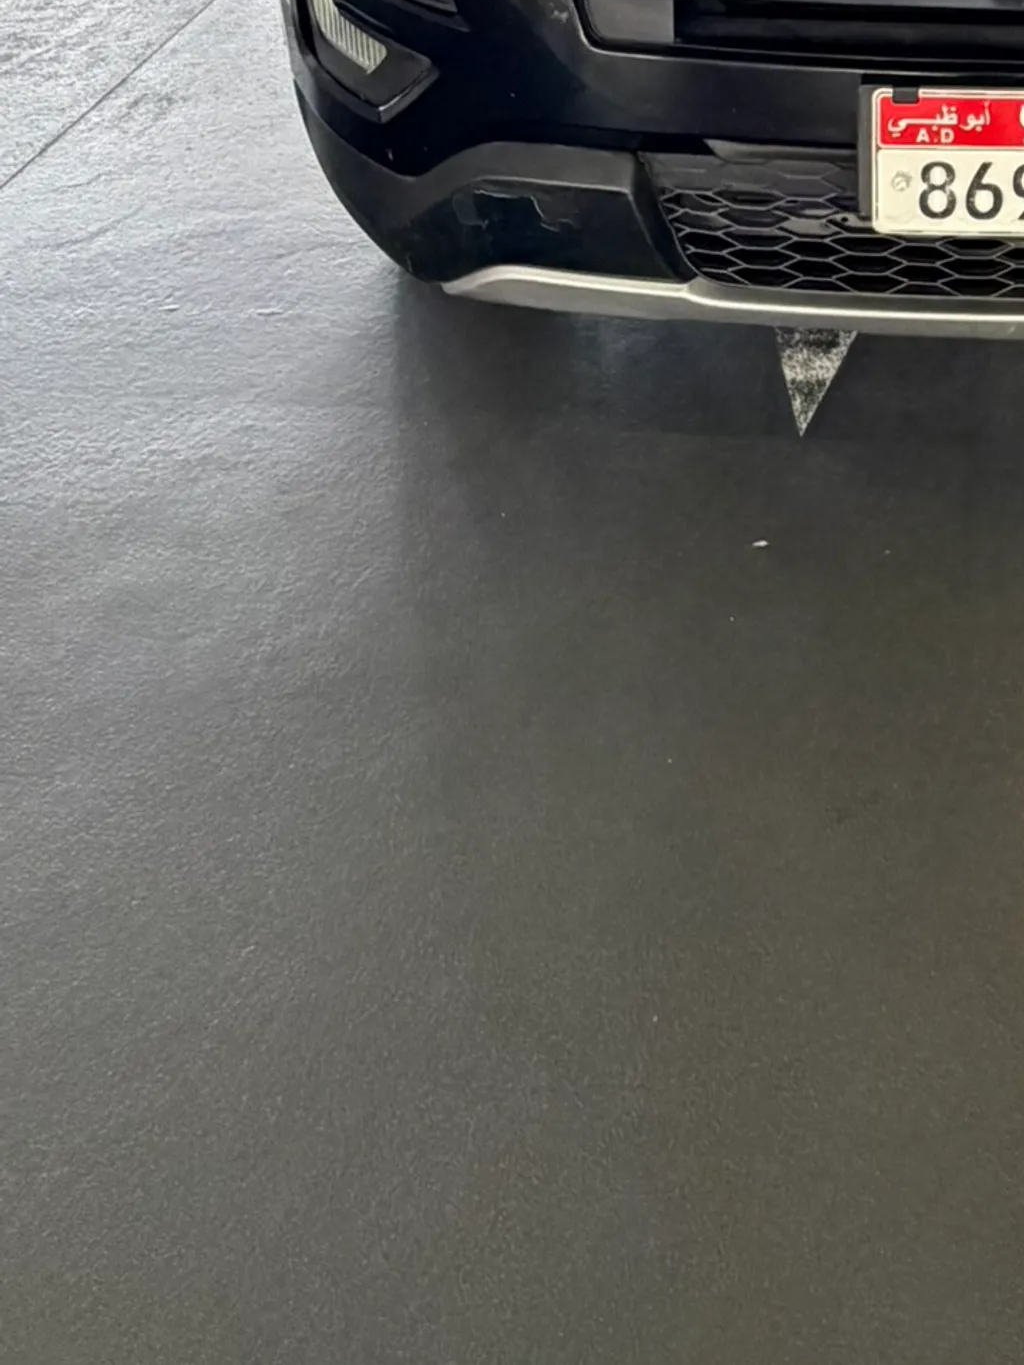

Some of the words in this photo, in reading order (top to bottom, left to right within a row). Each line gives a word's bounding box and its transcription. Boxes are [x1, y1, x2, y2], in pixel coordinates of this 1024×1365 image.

[887, 103, 958, 138] ظبي
[959, 99, 991, 132] أبو
[915, 127, 955, 143] A.D
